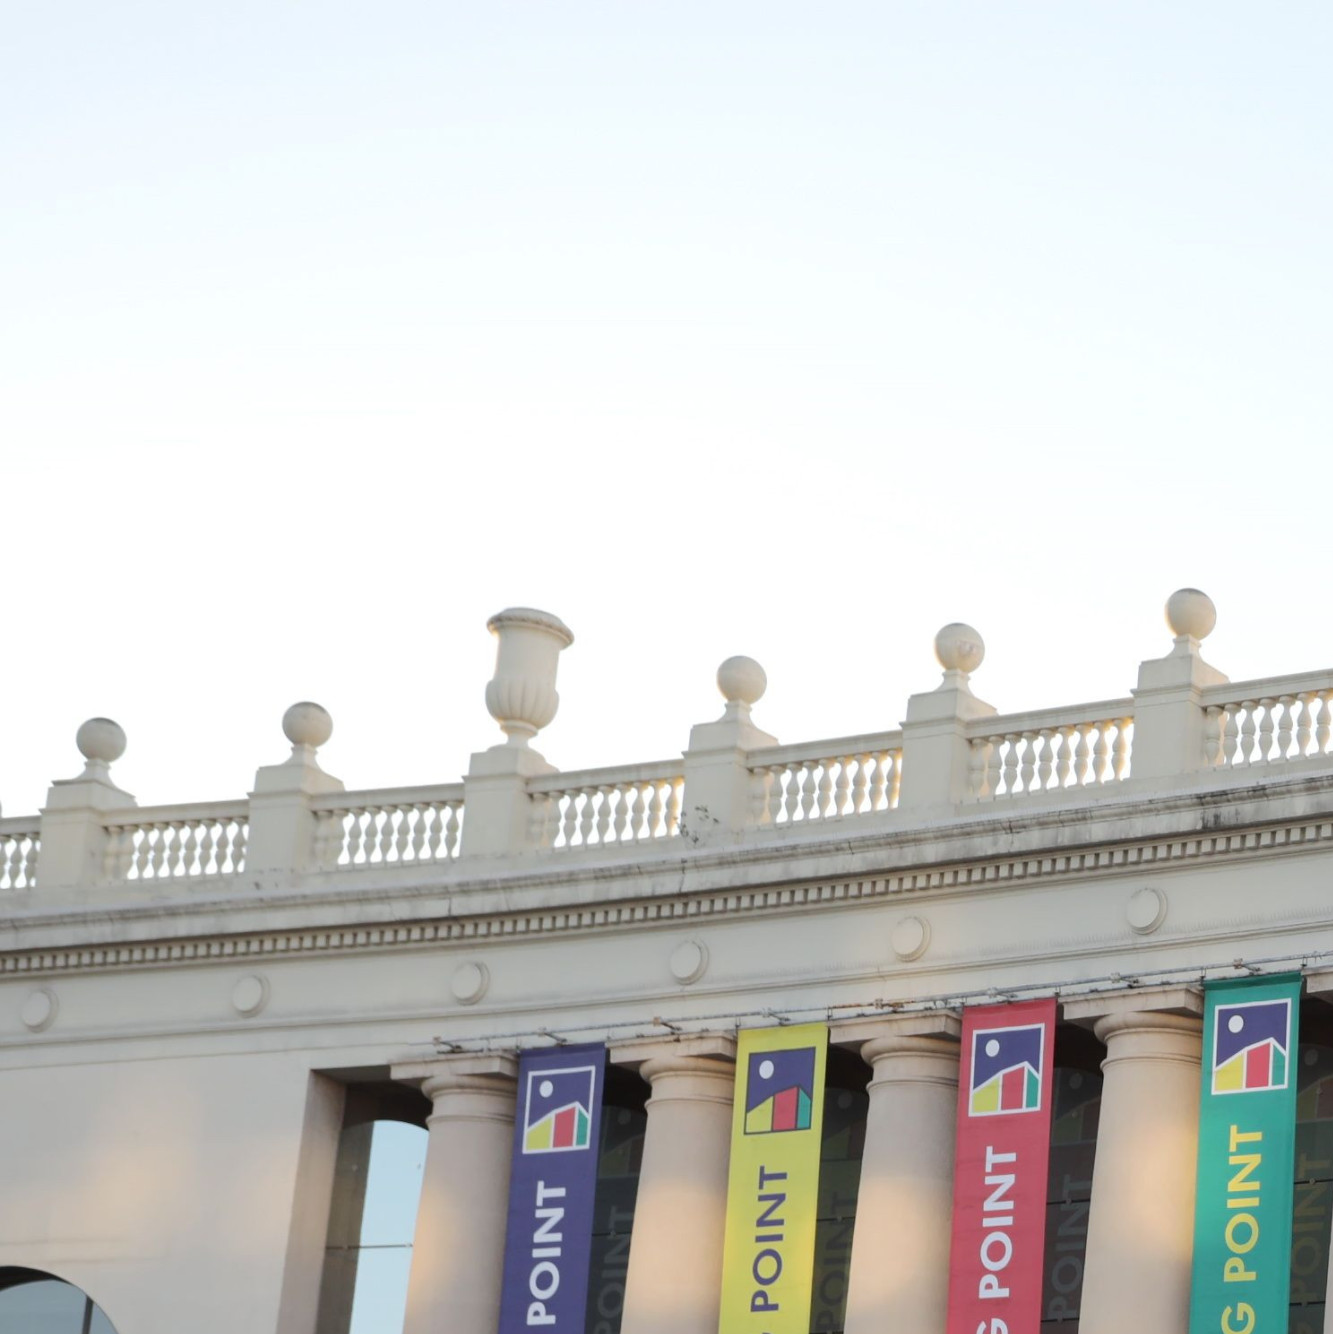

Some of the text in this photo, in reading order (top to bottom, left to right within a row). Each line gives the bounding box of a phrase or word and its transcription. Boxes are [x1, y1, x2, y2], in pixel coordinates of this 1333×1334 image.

[525, 1179, 567, 1326] POINT
[750, 1166, 789, 1313] POINT
[977, 1144, 1019, 1301] POINT
[1223, 1125, 1263, 1281] POINT
